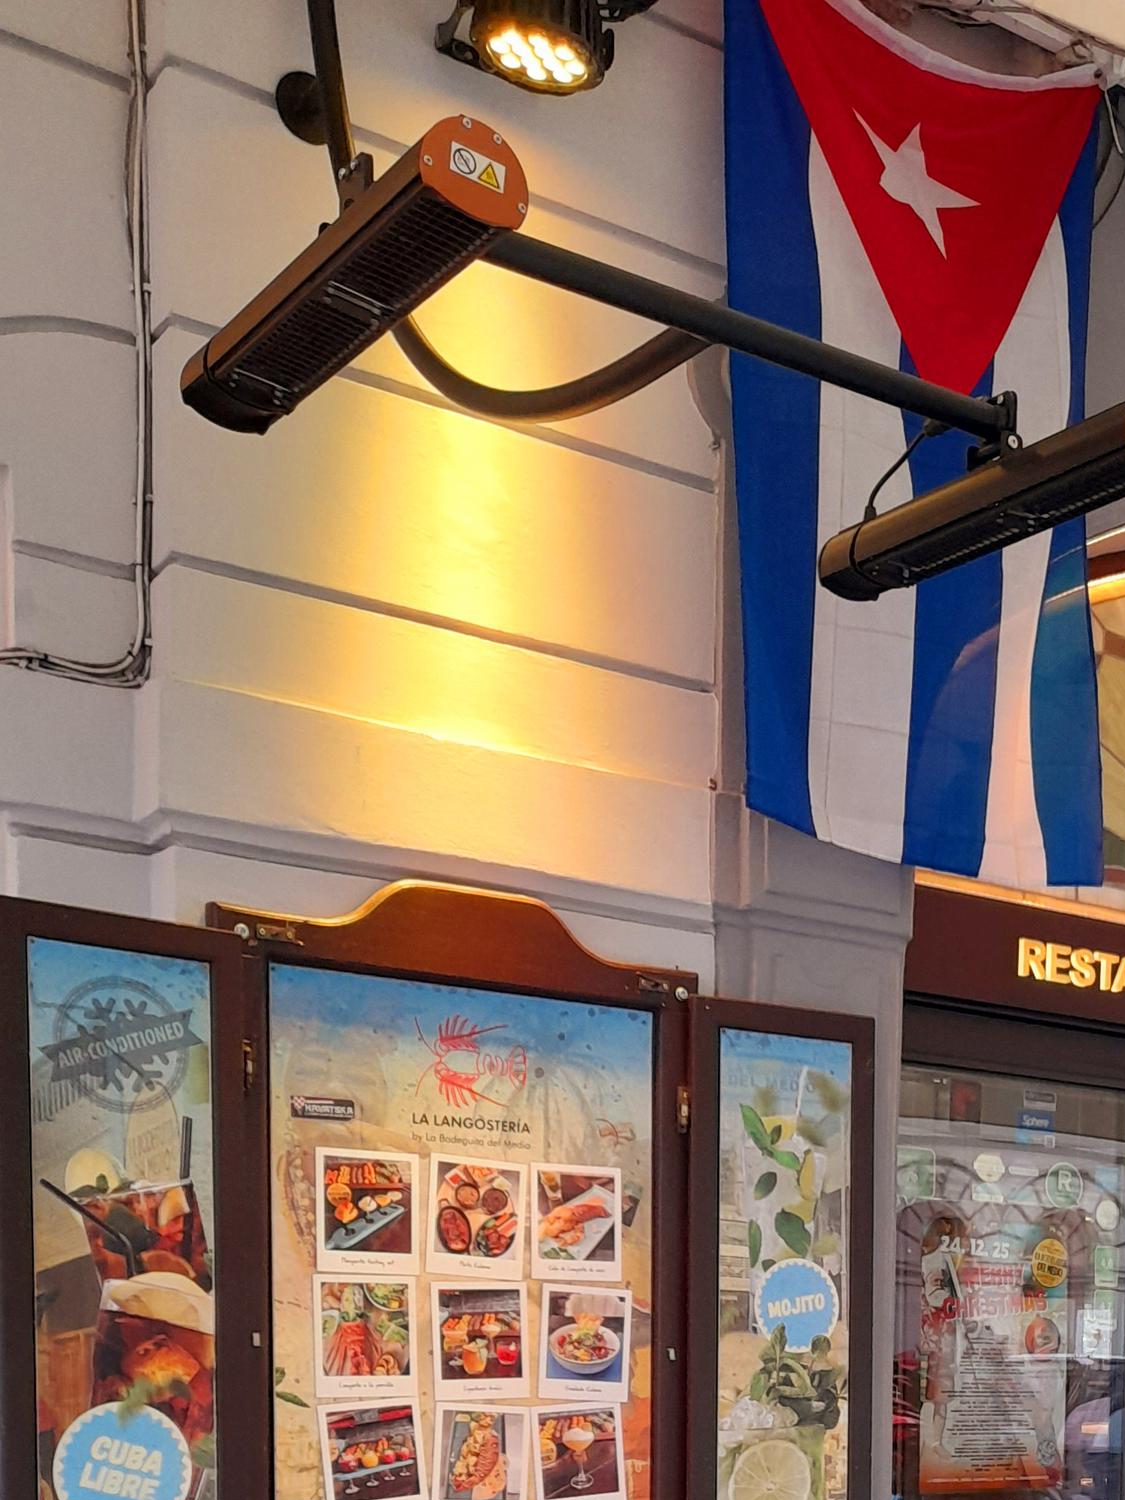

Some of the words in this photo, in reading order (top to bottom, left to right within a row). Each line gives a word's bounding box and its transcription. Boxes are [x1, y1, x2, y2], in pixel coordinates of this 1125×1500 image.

[58, 1021, 185, 1069] AIR-CONDITIONED
[411, 1112, 430, 1126] LA
[411, 1131, 422, 1143] by
[425, 1132, 437, 1142] La
[991, 1241, 1010, 1259] 25
[767, 1293, 825, 1319] MOJITO
[90, 1435, 163, 1477] CUBA
